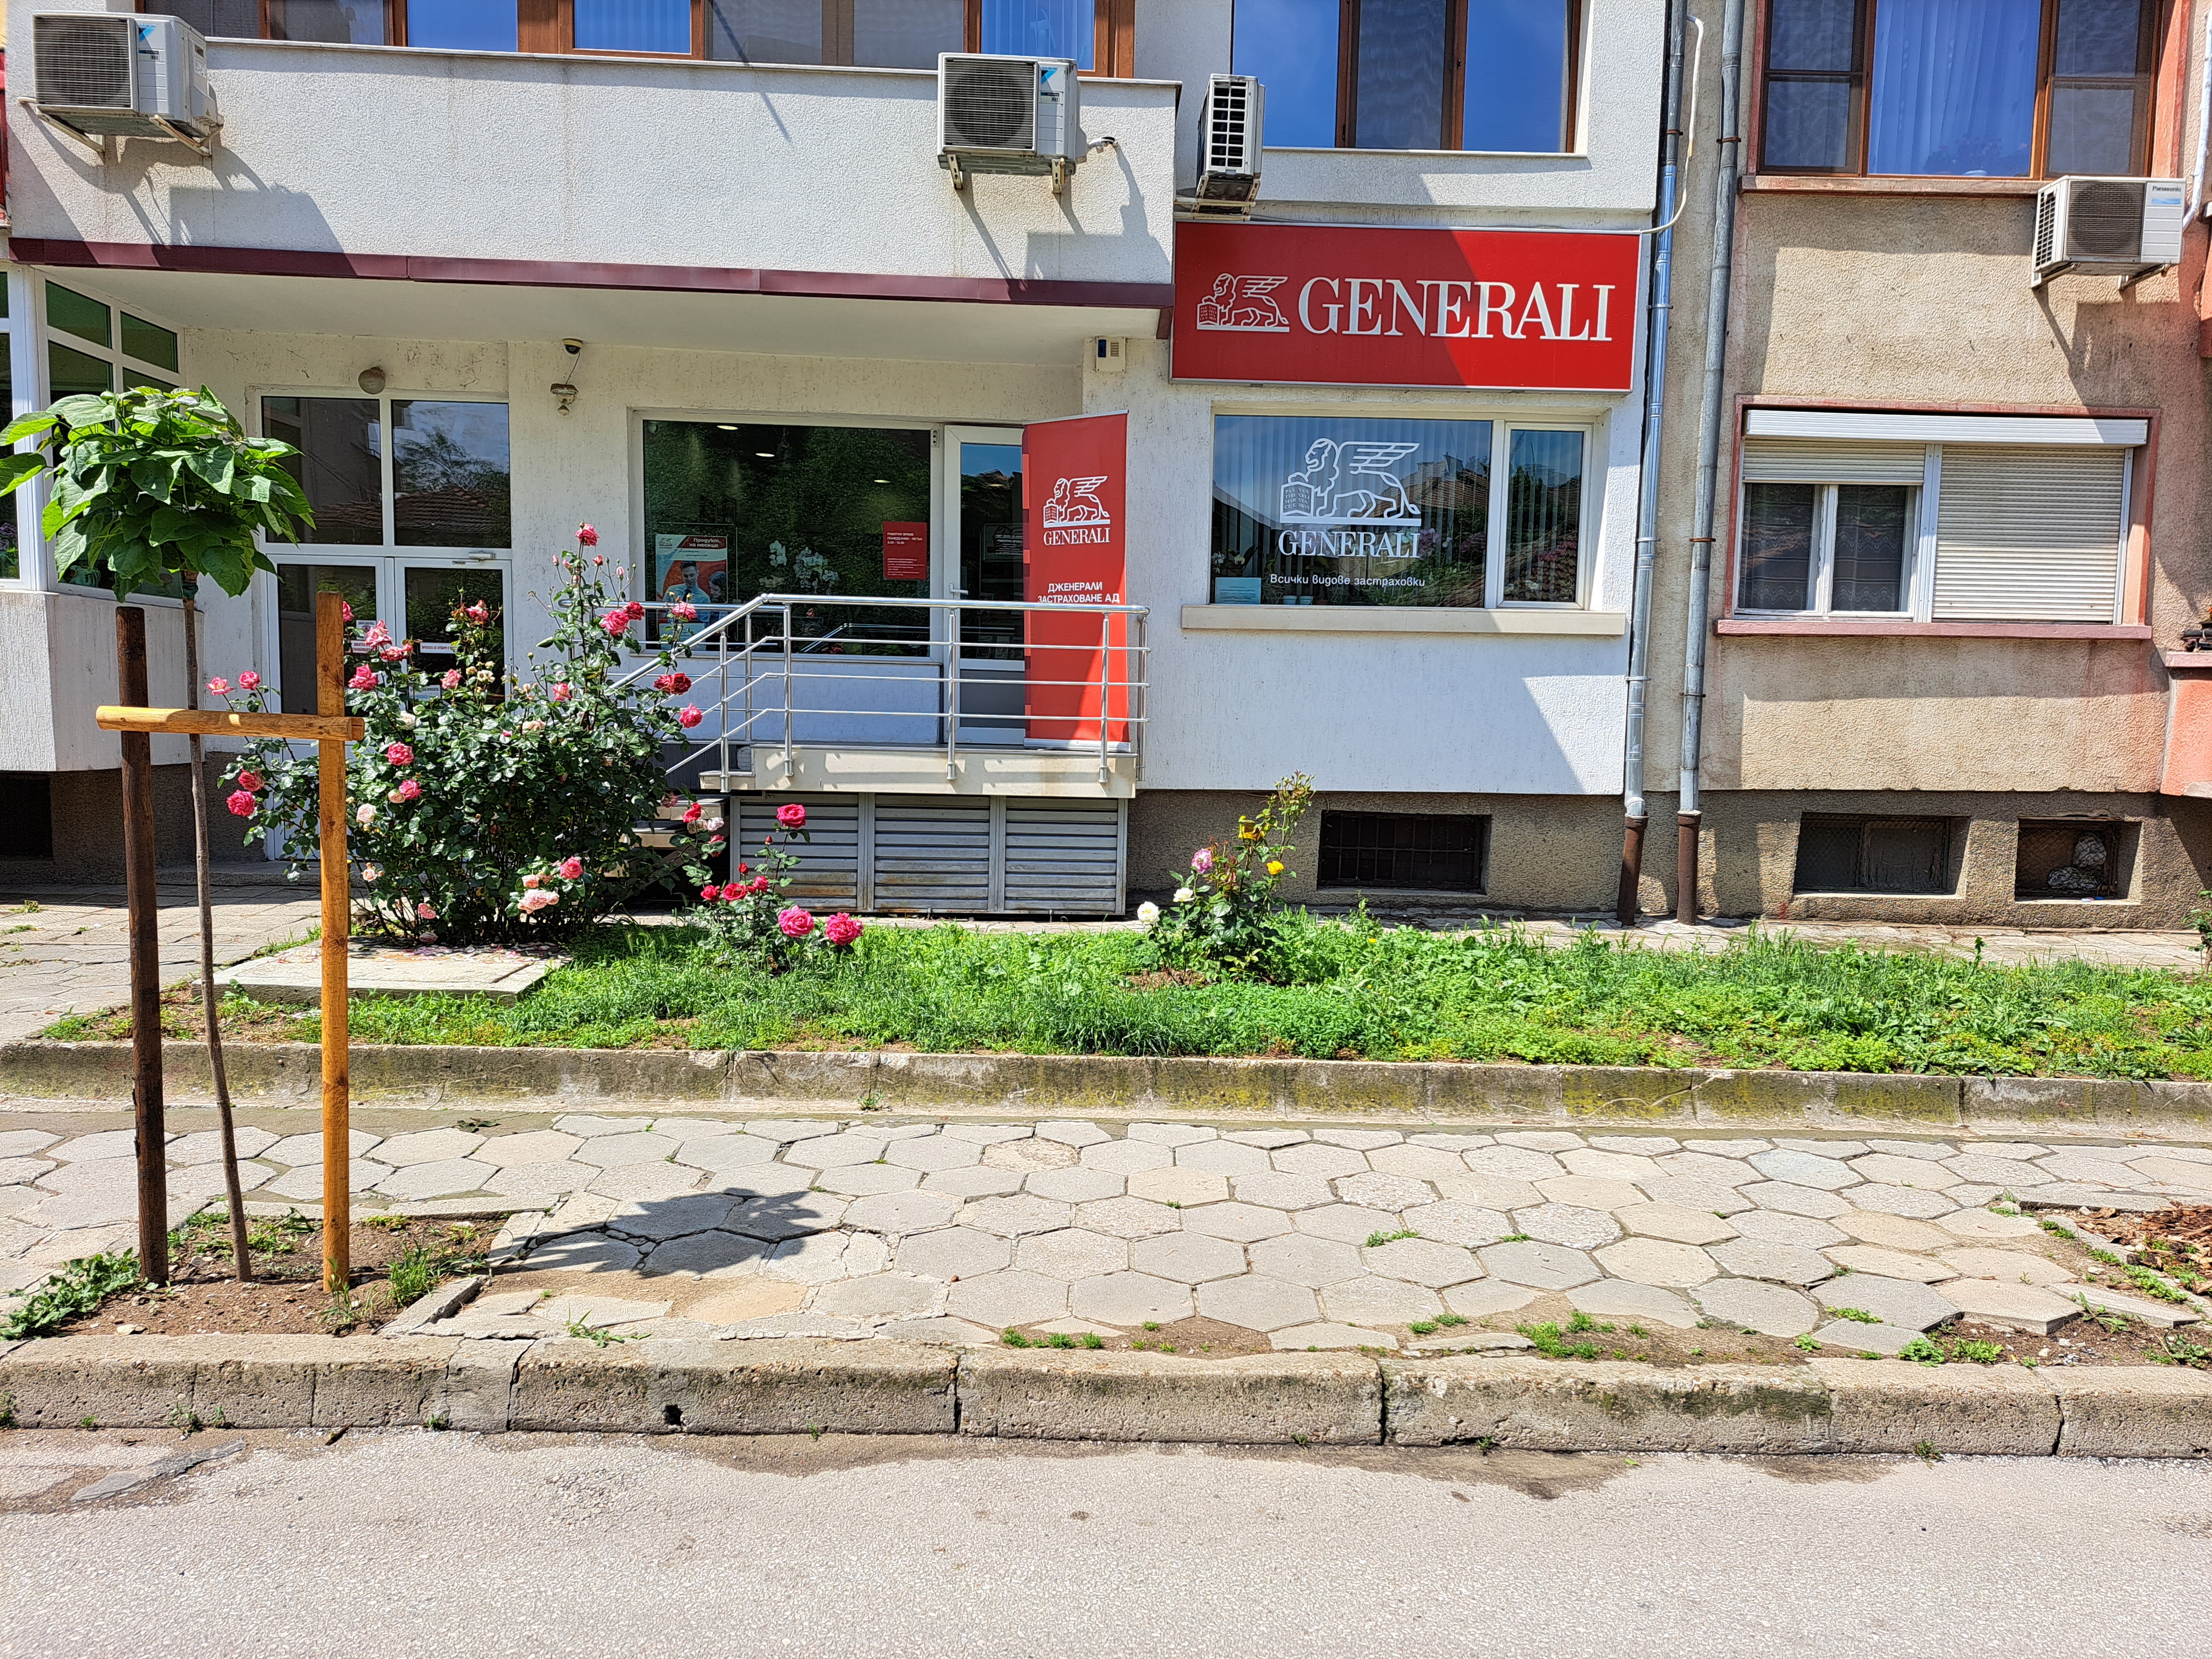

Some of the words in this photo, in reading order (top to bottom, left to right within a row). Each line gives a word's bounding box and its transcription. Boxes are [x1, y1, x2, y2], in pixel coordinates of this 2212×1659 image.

[1297, 276, 1615, 341] GENERALI
[1043, 528, 1110, 546] GENERALI
[1278, 530, 1421, 558] GENERALI
[1048, 582, 1103, 593] ДЖЕНЕРАЛИ
[1270, 574, 1309, 584] Всички
[1312, 575, 1350, 586] видове
[1354, 576, 1425, 587] застраховки
[1038, 594, 1102, 603] ЗАСТРАХОВАНЕ
[1105, 593, 1120, 604] АД
